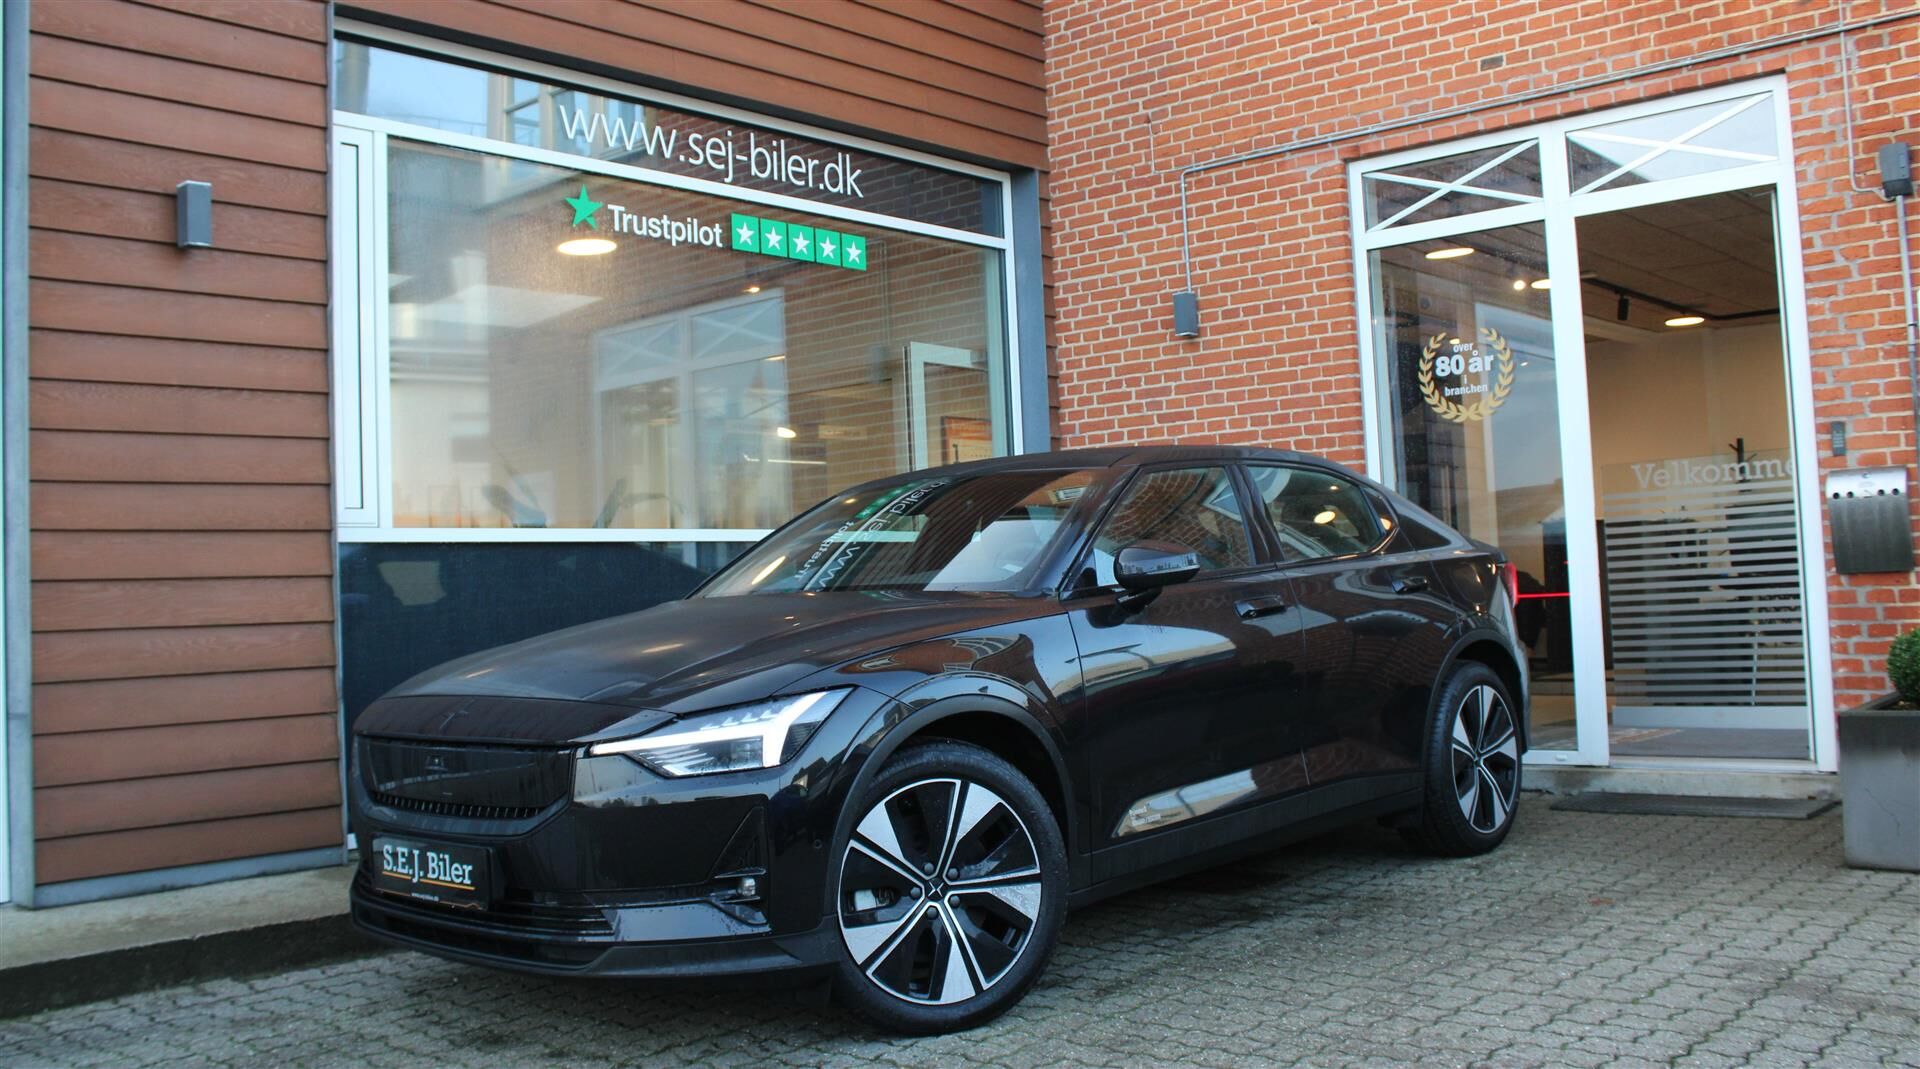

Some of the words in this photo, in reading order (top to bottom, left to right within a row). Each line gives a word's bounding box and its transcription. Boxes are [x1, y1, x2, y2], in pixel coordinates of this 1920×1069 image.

[559, 104, 864, 198] www.sej-biler.dk
[607, 204, 723, 249] Trustpilot
[1435, 354, 1465, 377] 80
[1468, 350, 1494, 373] år
[1453, 342, 1474, 353] over
[1444, 383, 1488, 397] branchen
[382, 844, 424, 883] S.E.J.
[427, 852, 473, 884] Biler
